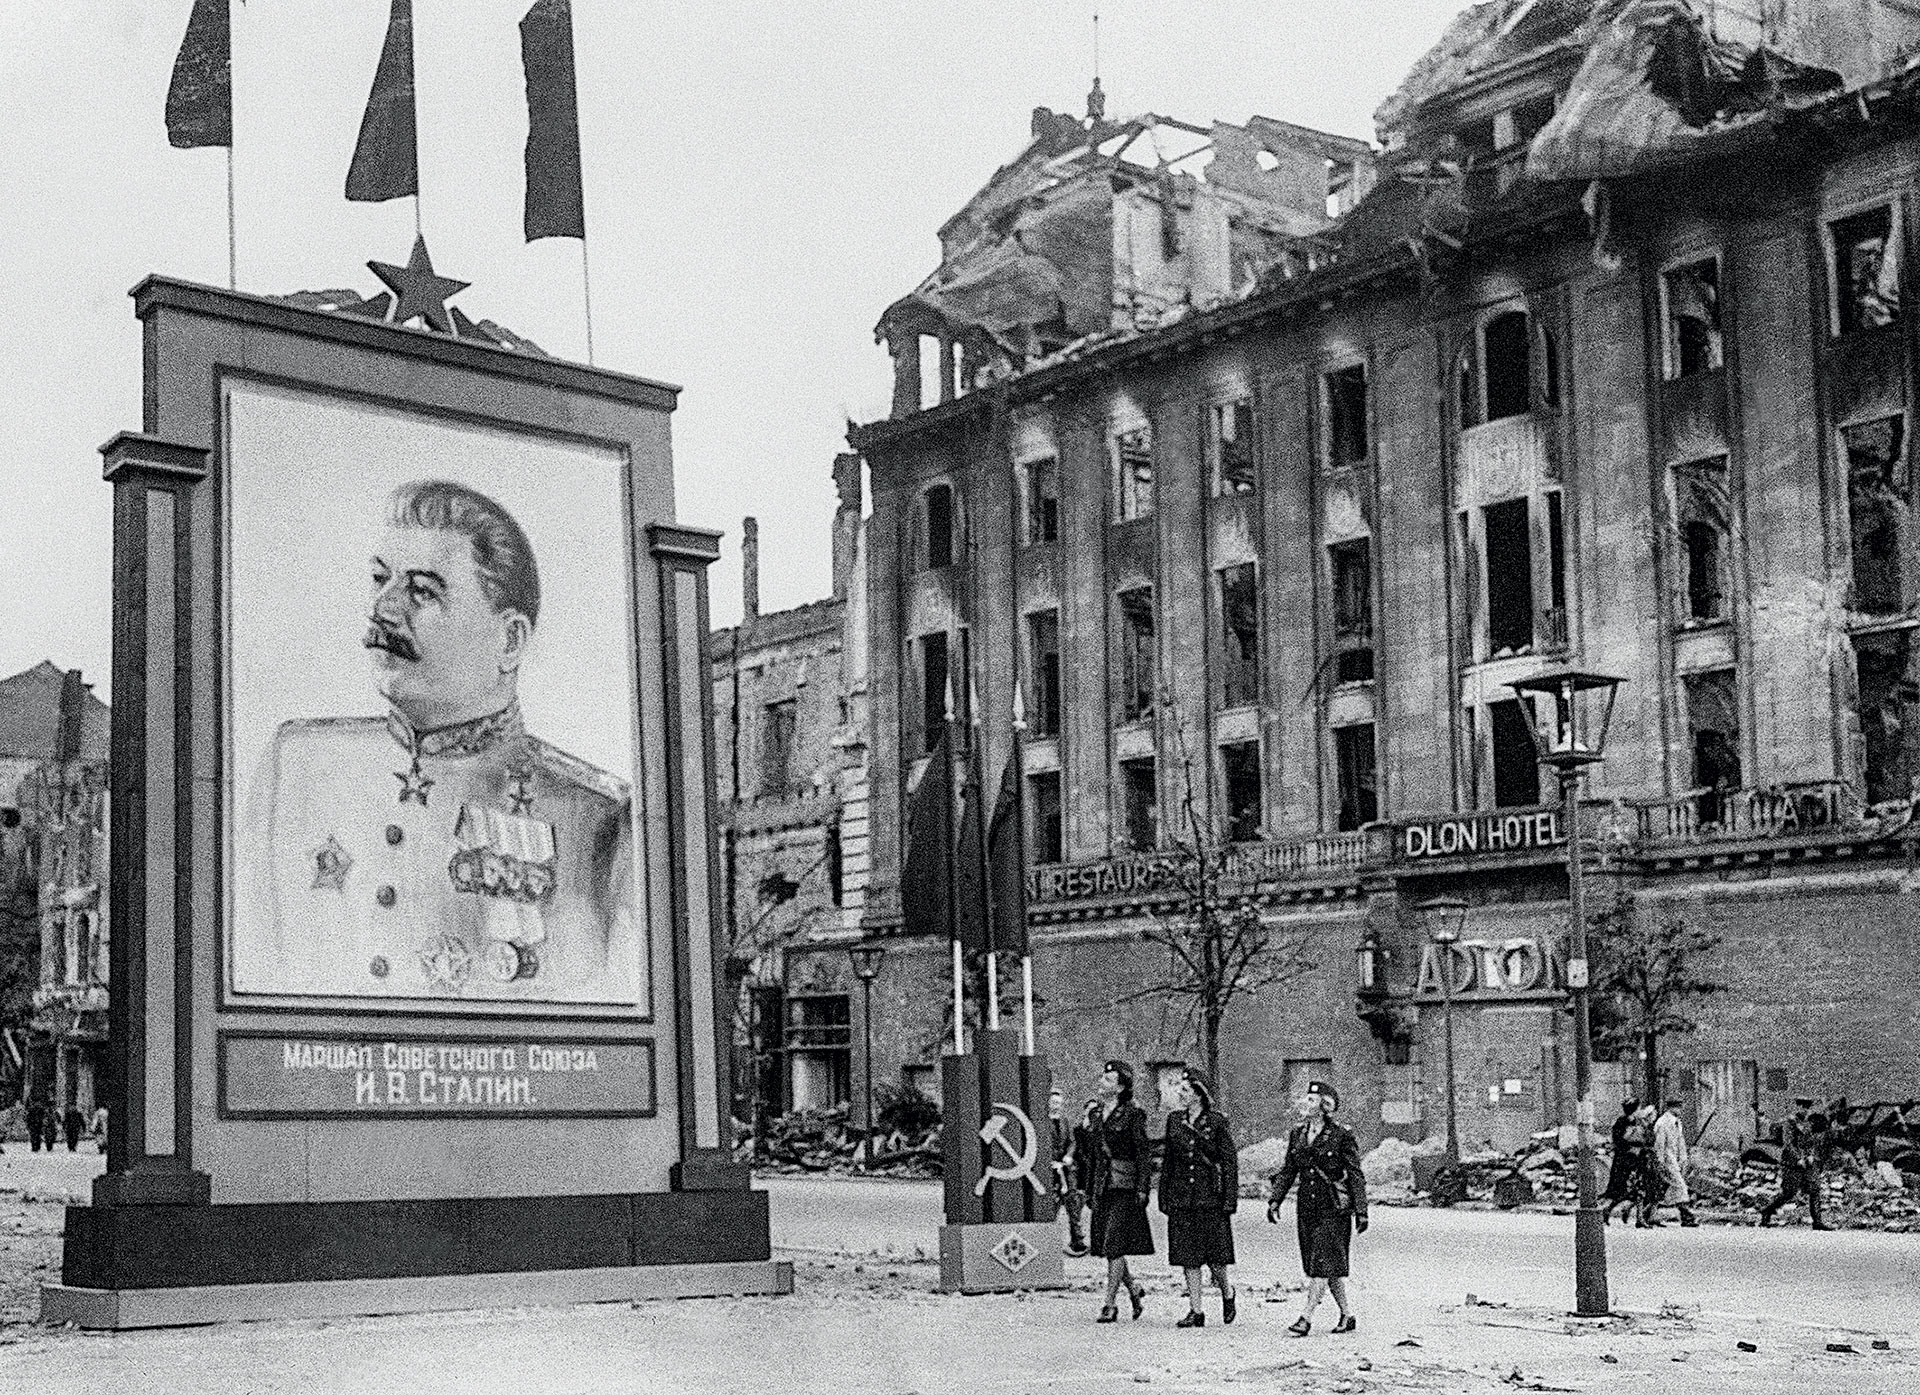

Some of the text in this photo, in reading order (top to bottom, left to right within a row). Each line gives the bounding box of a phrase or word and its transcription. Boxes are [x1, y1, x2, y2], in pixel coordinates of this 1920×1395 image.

[1406, 812, 1569, 857] DLON HOTEL
[283, 1042, 599, 1072] МАРШАЛ СОВЕТСКОГО СОЮЗА
